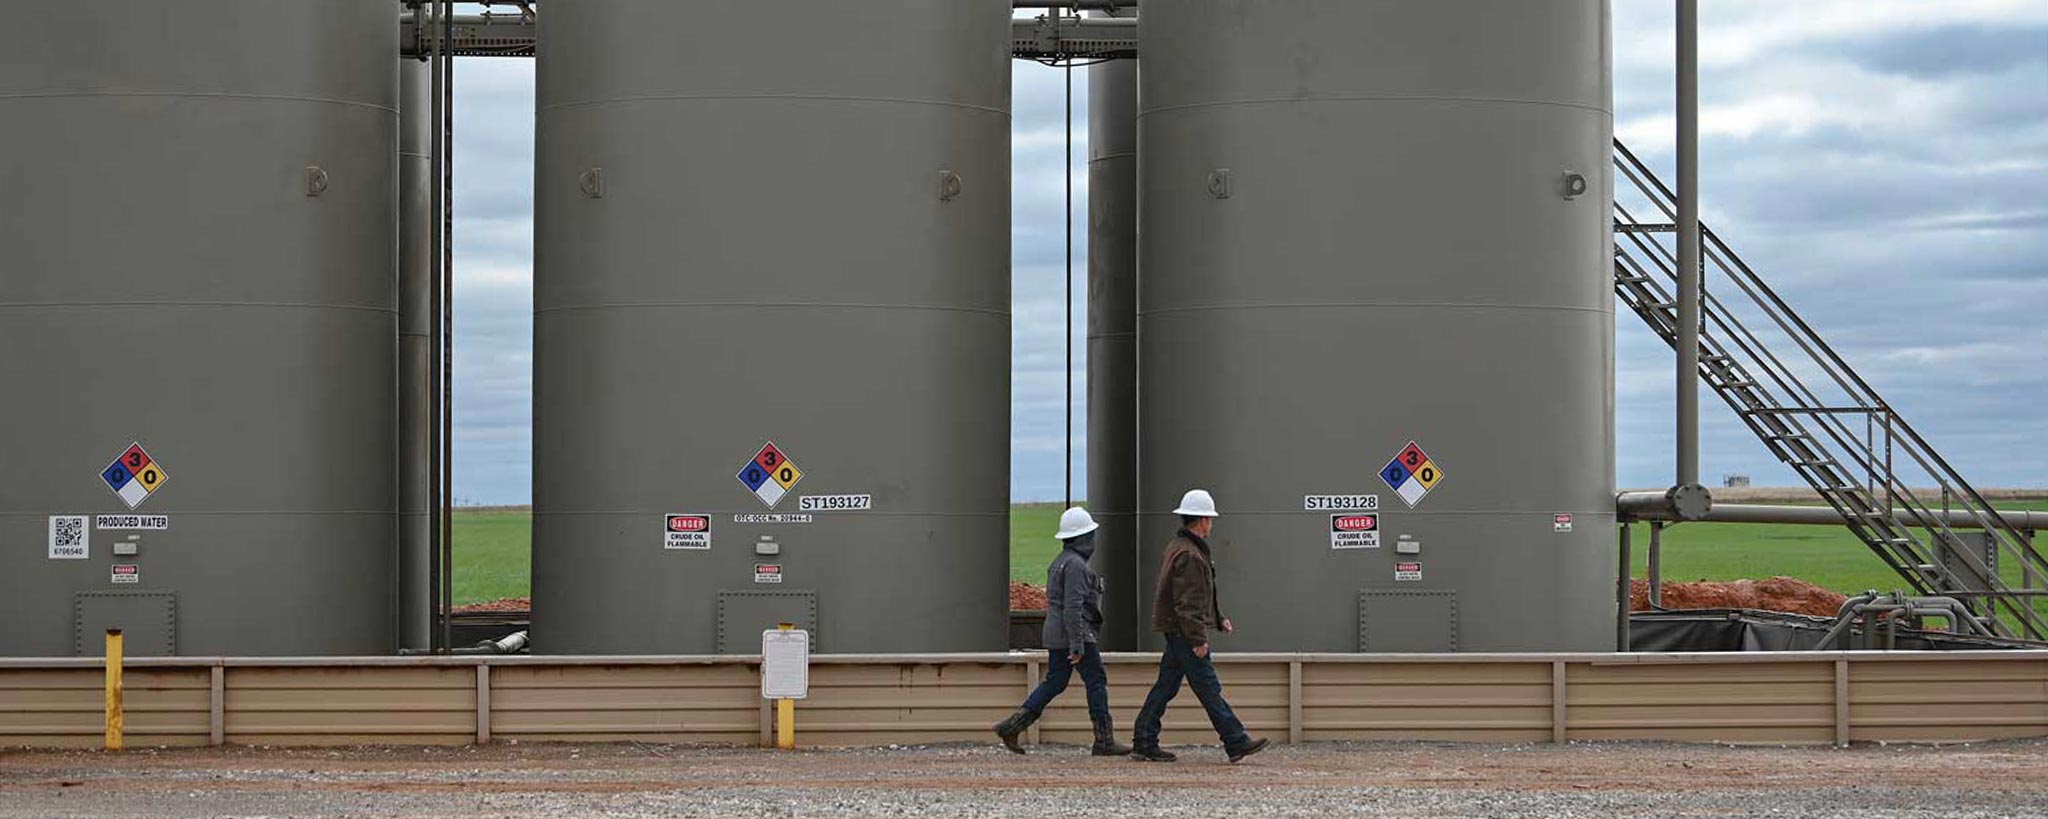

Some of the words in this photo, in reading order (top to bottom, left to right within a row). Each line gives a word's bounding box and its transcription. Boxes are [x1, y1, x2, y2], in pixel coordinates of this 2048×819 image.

[129, 453, 141, 467] 3
[764, 452, 776, 466] 3
[1406, 451, 1419, 465] 3
[112, 469, 124, 483] 0
[144, 470, 156, 484] 0
[749, 469, 761, 483] 0
[780, 468, 793, 482] 0
[1390, 467, 1402, 481] 0
[1422, 468, 1434, 482] 0
[801, 496, 869, 509] ST193127
[1307, 496, 1376, 508] ST193128
[98, 516, 139, 527] PRODUCED
[141, 516, 167, 527] WATER
[672, 519, 703, 529] DANGER
[1338, 518, 1371, 528] DANGER
